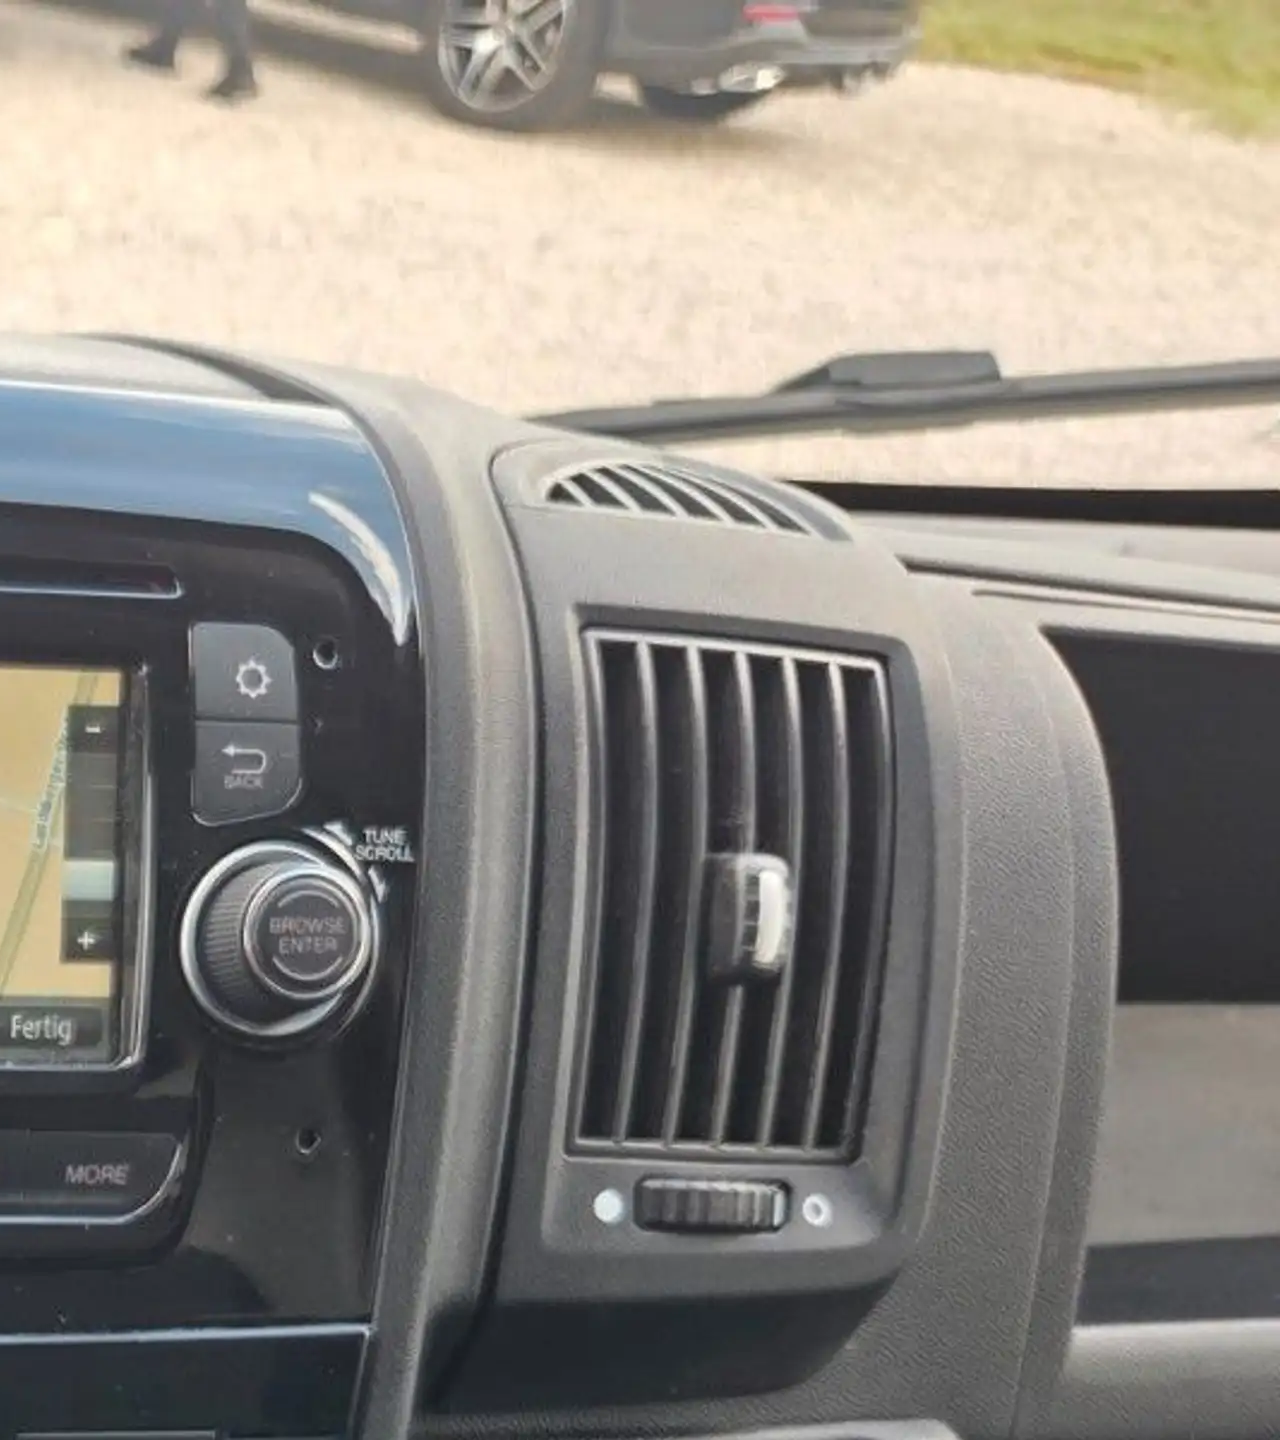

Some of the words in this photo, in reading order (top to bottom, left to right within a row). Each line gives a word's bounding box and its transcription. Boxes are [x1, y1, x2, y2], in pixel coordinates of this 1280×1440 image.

[223, 775, 264, 790] BACK
[363, 828, 406, 844] TUNE
[355, 845, 414, 863] SCROLL
[269, 917, 347, 936] BROWSE
[278, 936, 339, 954] ENTER
[9, 1012, 73, 1044] Fertig
[64, 1163, 131, 1185] MORE
